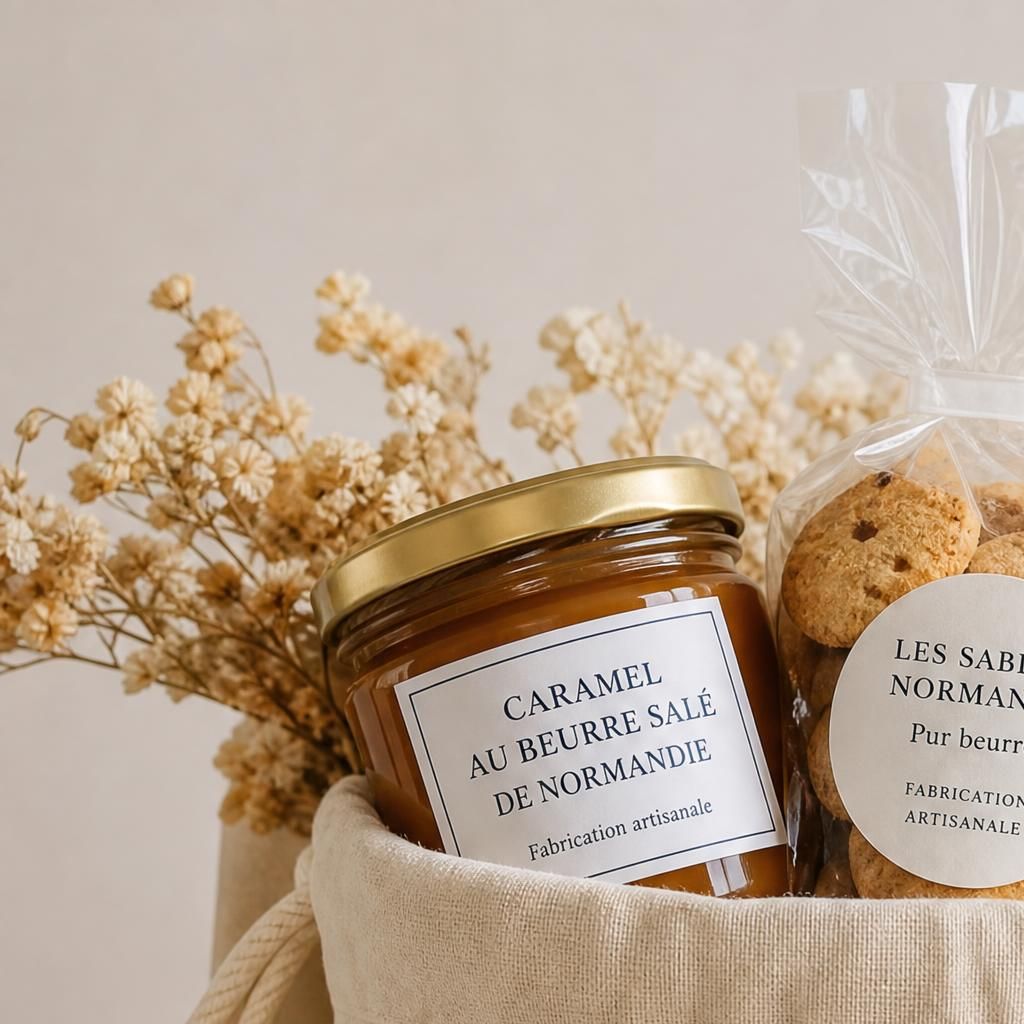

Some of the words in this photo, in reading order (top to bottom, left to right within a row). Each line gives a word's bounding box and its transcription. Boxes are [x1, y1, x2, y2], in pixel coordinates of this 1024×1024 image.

[894, 638, 948, 665] LES
[503, 662, 662, 721] CARAMEL
[469, 744, 508, 780] AU
[516, 709, 642, 764] BEURRE
[648, 688, 717, 728] SALÉ
[909, 723, 951, 746] Pur
[493, 785, 534, 817] DE
[537, 738, 712, 803] NORMANDIE
[528, 822, 628, 861] Fabrication
[632, 799, 714, 833] artisanale
[904, 810, 1021, 836] ARTISANALE
